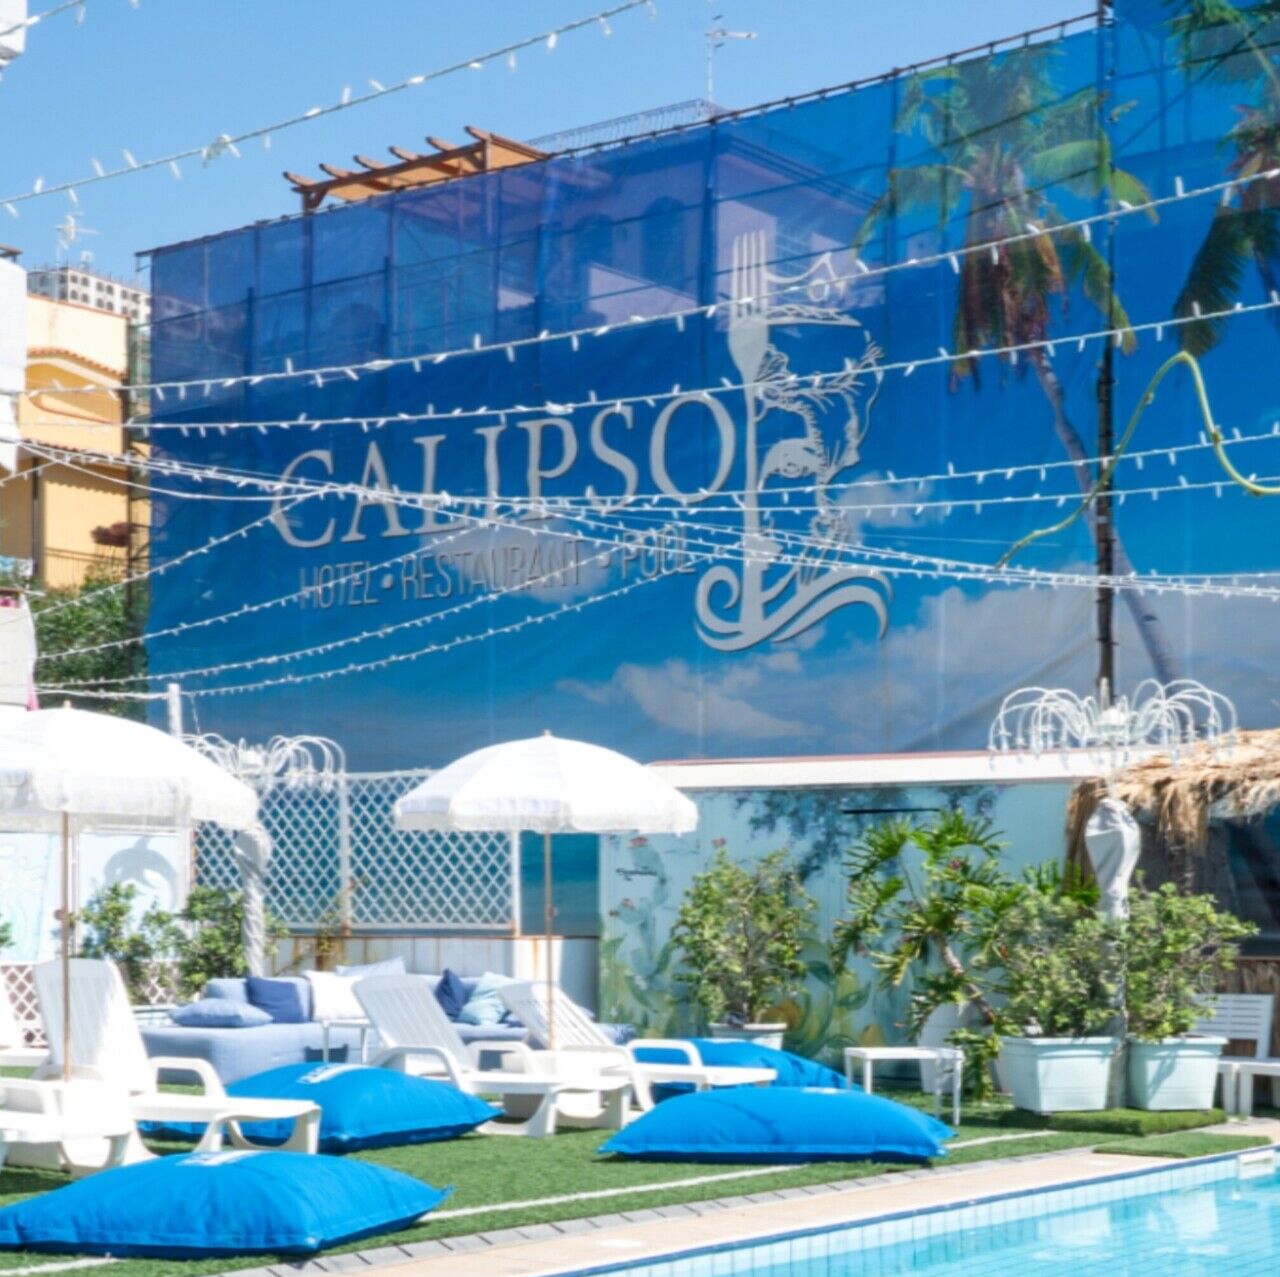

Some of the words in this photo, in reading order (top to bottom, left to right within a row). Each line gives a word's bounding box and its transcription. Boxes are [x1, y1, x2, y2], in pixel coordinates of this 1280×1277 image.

[271, 393, 737, 549] CALIPSO
[299, 560, 379, 609] HOTEL
[401, 539, 585, 601] RESTAURANT
[622, 524, 696, 579] POOL
